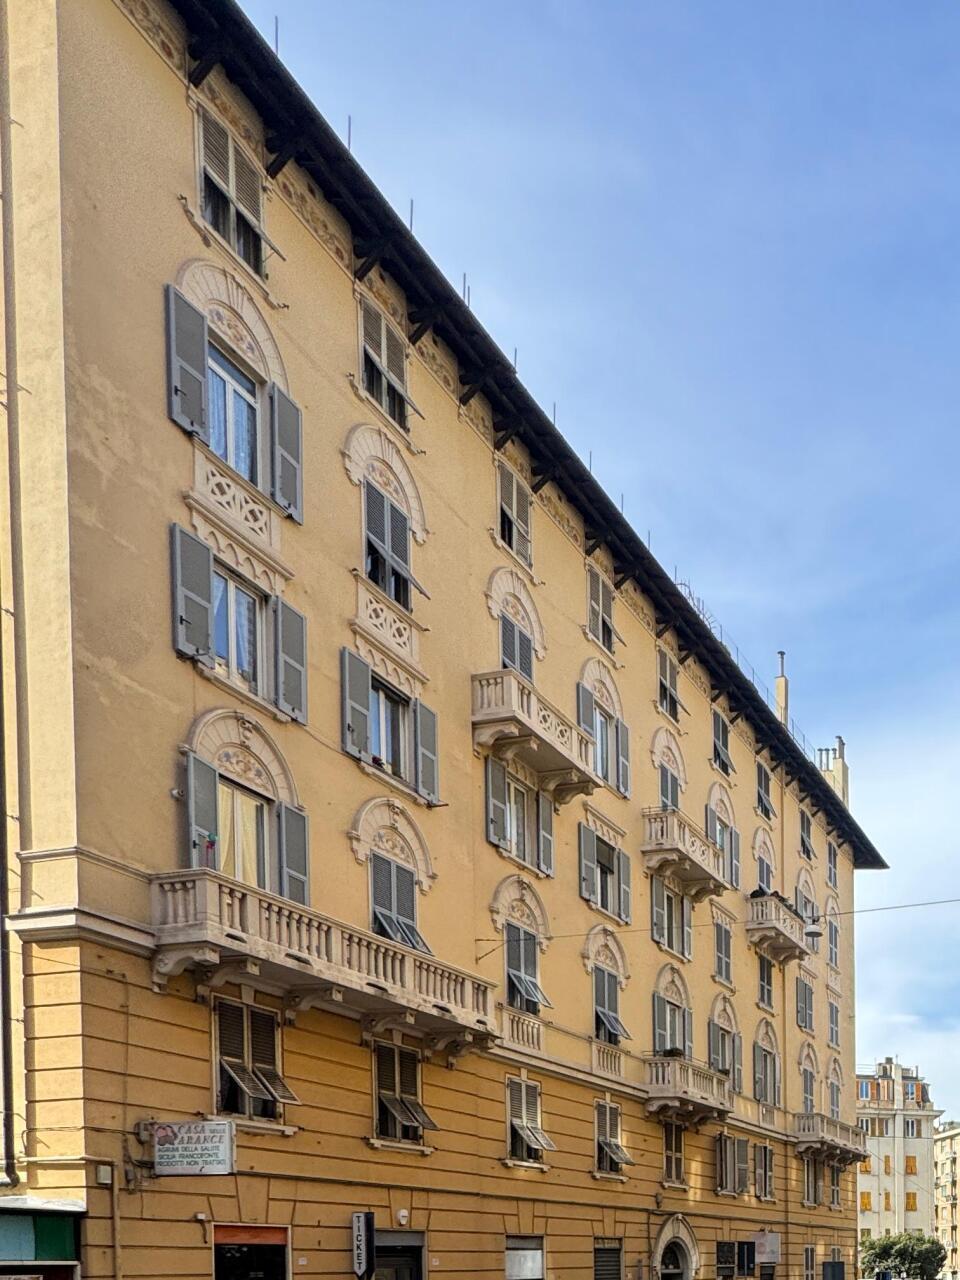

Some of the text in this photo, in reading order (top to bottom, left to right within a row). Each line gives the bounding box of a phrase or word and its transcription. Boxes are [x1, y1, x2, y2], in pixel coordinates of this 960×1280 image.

[178, 1125, 206, 1135] CASA
[176, 1135, 225, 1145] ARANCE
[355, 1215, 363, 1270] TICKET
